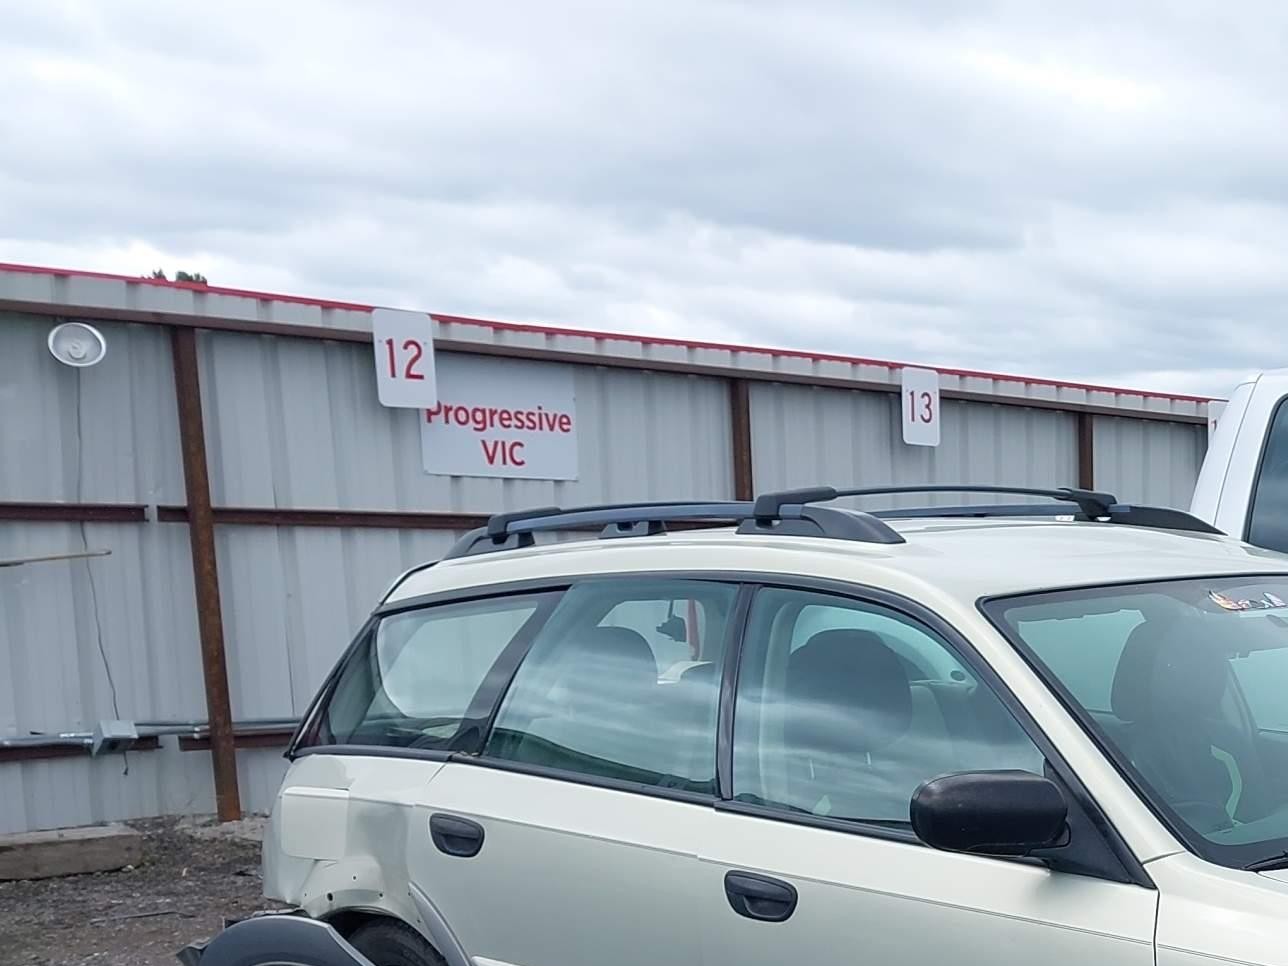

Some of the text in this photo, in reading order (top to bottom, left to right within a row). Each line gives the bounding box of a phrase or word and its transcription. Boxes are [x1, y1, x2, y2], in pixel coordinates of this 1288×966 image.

[385, 337, 425, 380] 12
[426, 400, 572, 433] Progressive
[910, 390, 933, 424] 13
[481, 439, 526, 466] VIC
